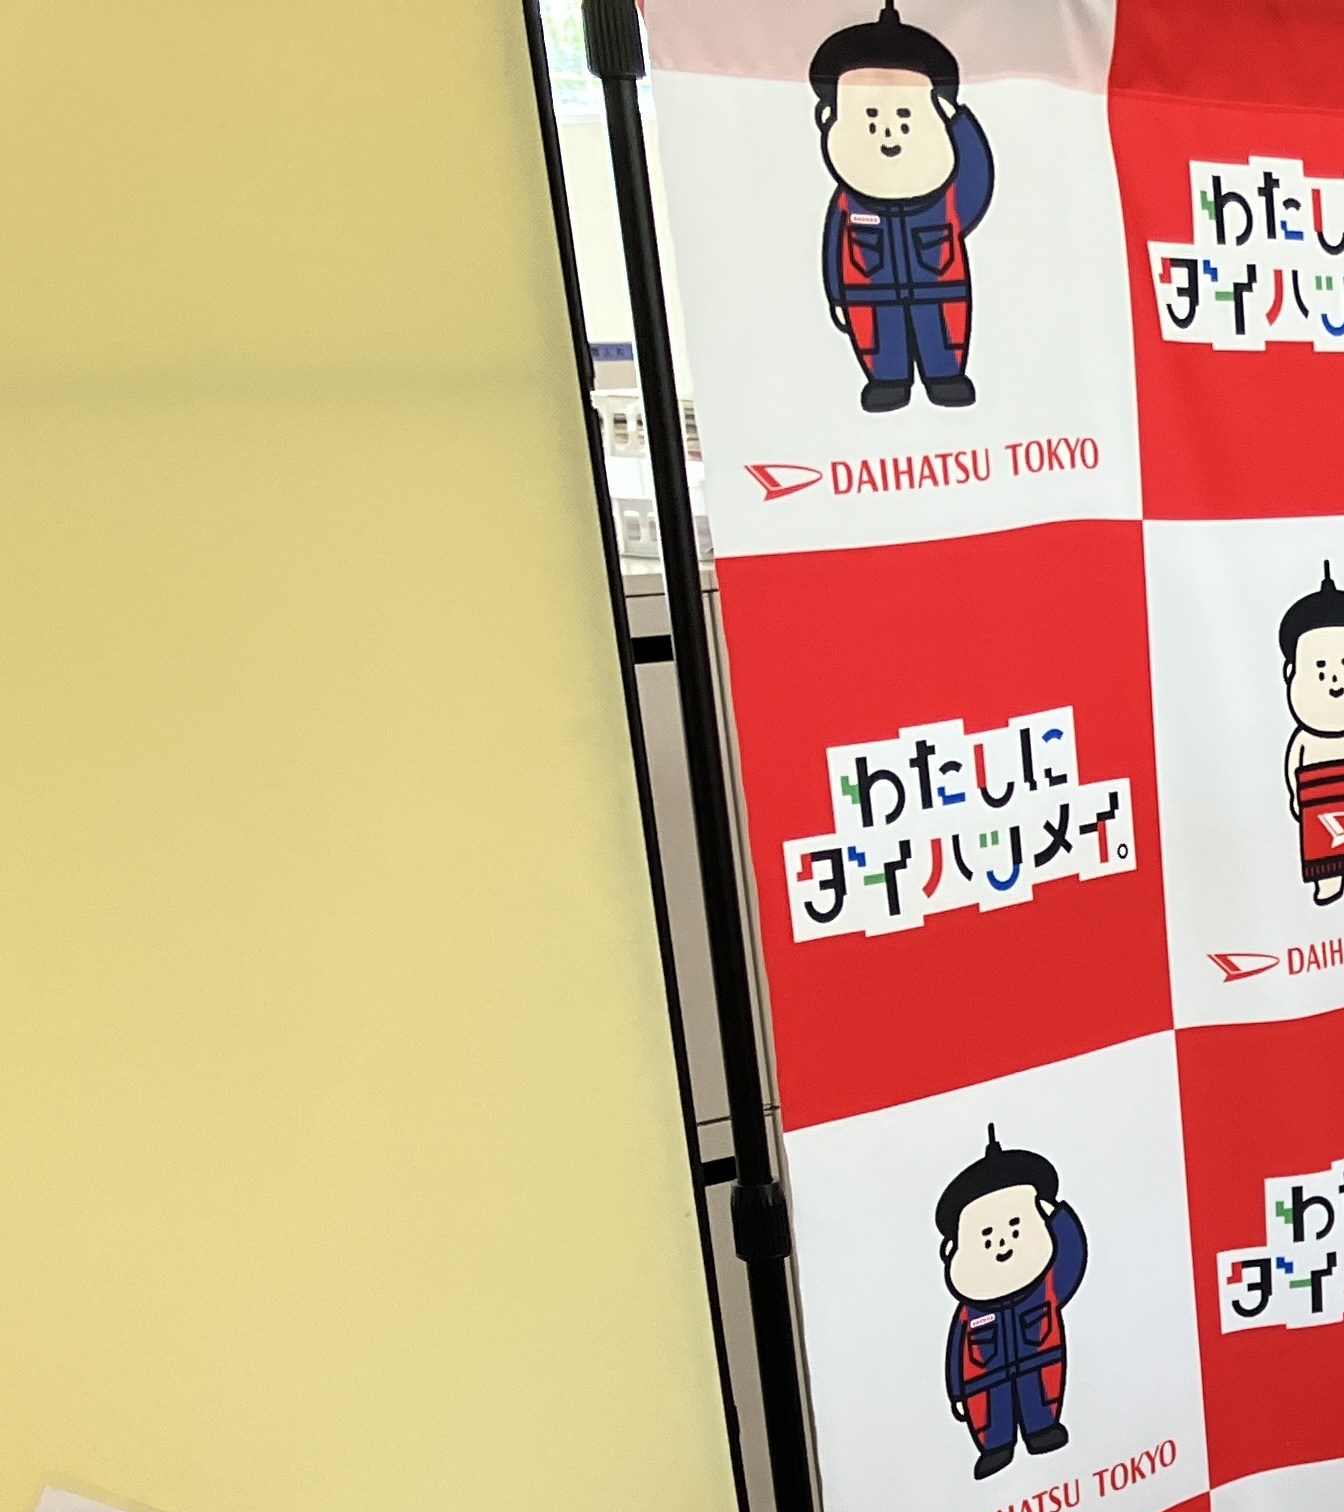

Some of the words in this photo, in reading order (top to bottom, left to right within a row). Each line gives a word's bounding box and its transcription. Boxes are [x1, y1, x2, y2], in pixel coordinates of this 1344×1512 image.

[830, 450, 991, 496] DAIHATSU
[1004, 437, 1099, 477] TOKYO
[840, 727, 1068, 829] わたしに
[796, 792, 1130, 924] ダイハツメイ。
[1091, 1438, 1178, 1496] TOKYO
